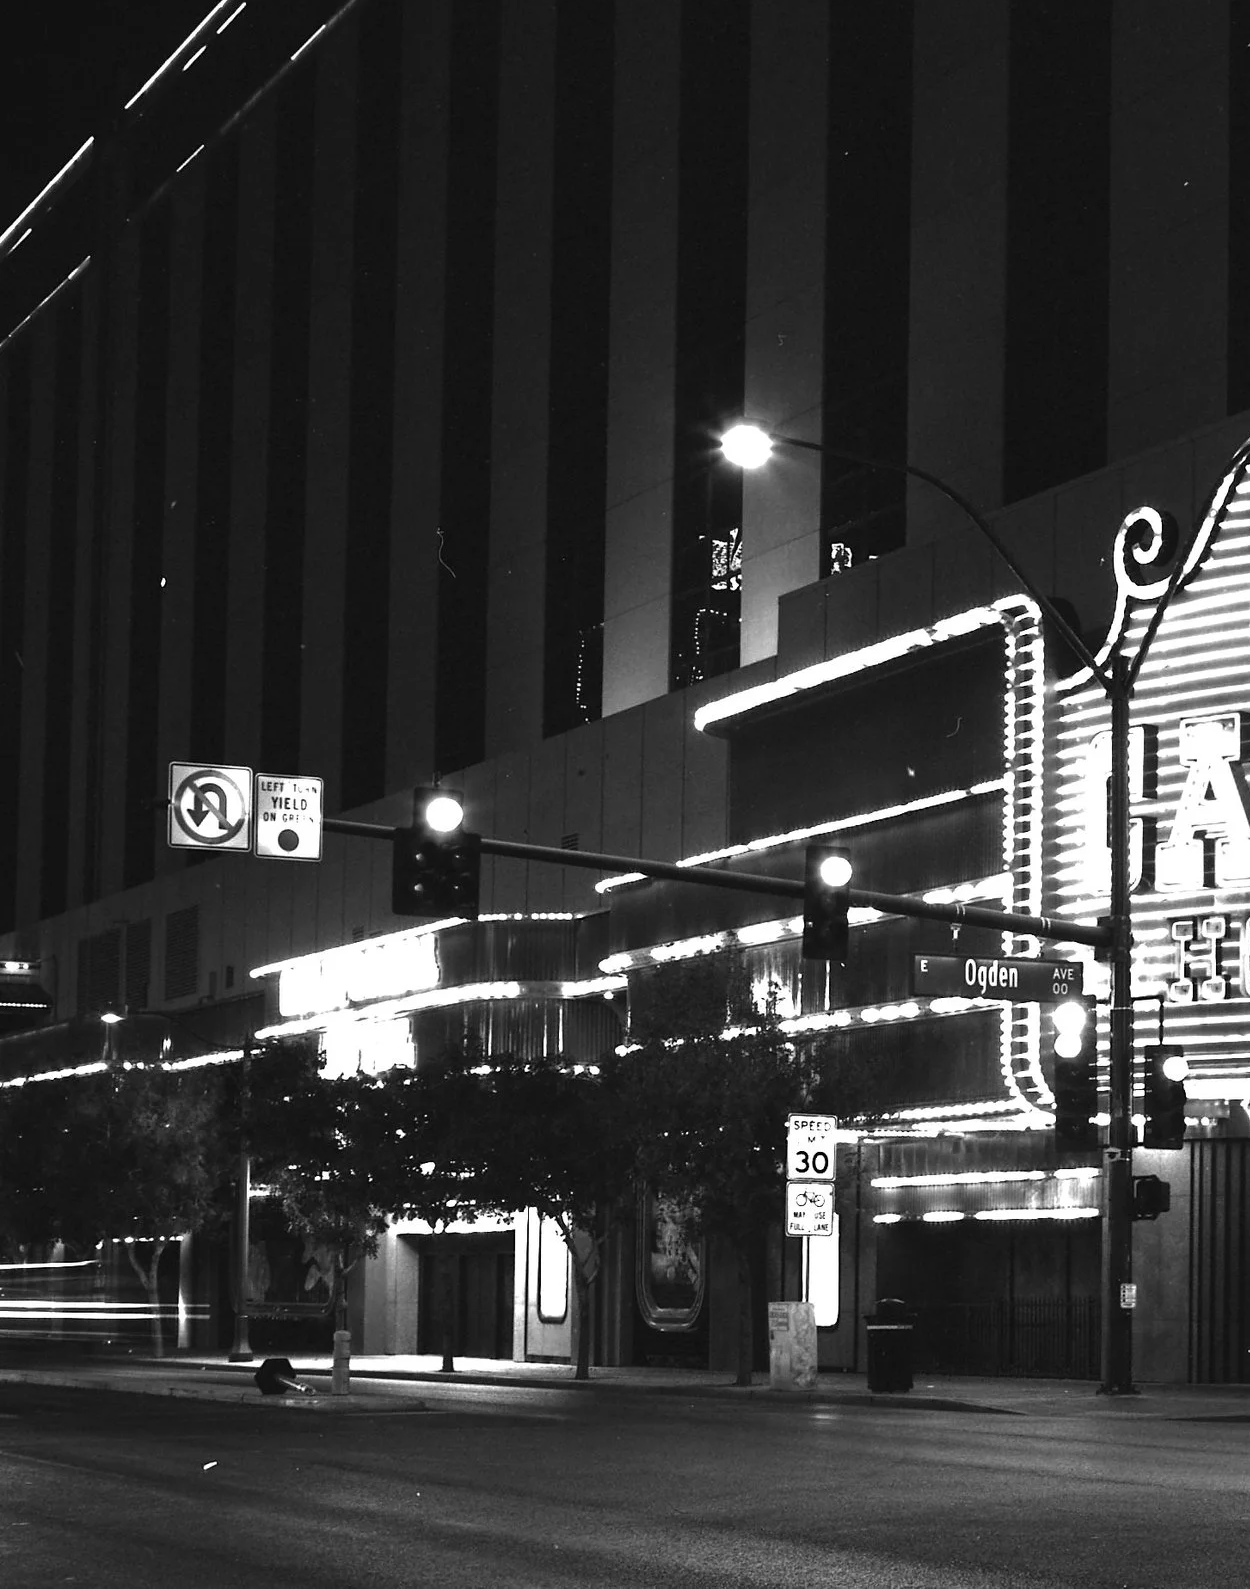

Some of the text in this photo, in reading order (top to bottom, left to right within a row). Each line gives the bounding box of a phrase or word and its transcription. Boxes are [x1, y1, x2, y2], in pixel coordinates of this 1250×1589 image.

[261, 781, 284, 792] LEFT
[271, 796, 307, 810] YIELD
[263, 811, 314, 823] ON GRE
[920, 959, 1074, 995] E Ogden AVE
[1053, 983, 1069, 995] 00
[794, 1120, 832, 1132] SPEED
[795, 1150, 829, 1174] 30
[814, 1211, 826, 1219] USE
[813, 1223, 829, 1231] LANE
